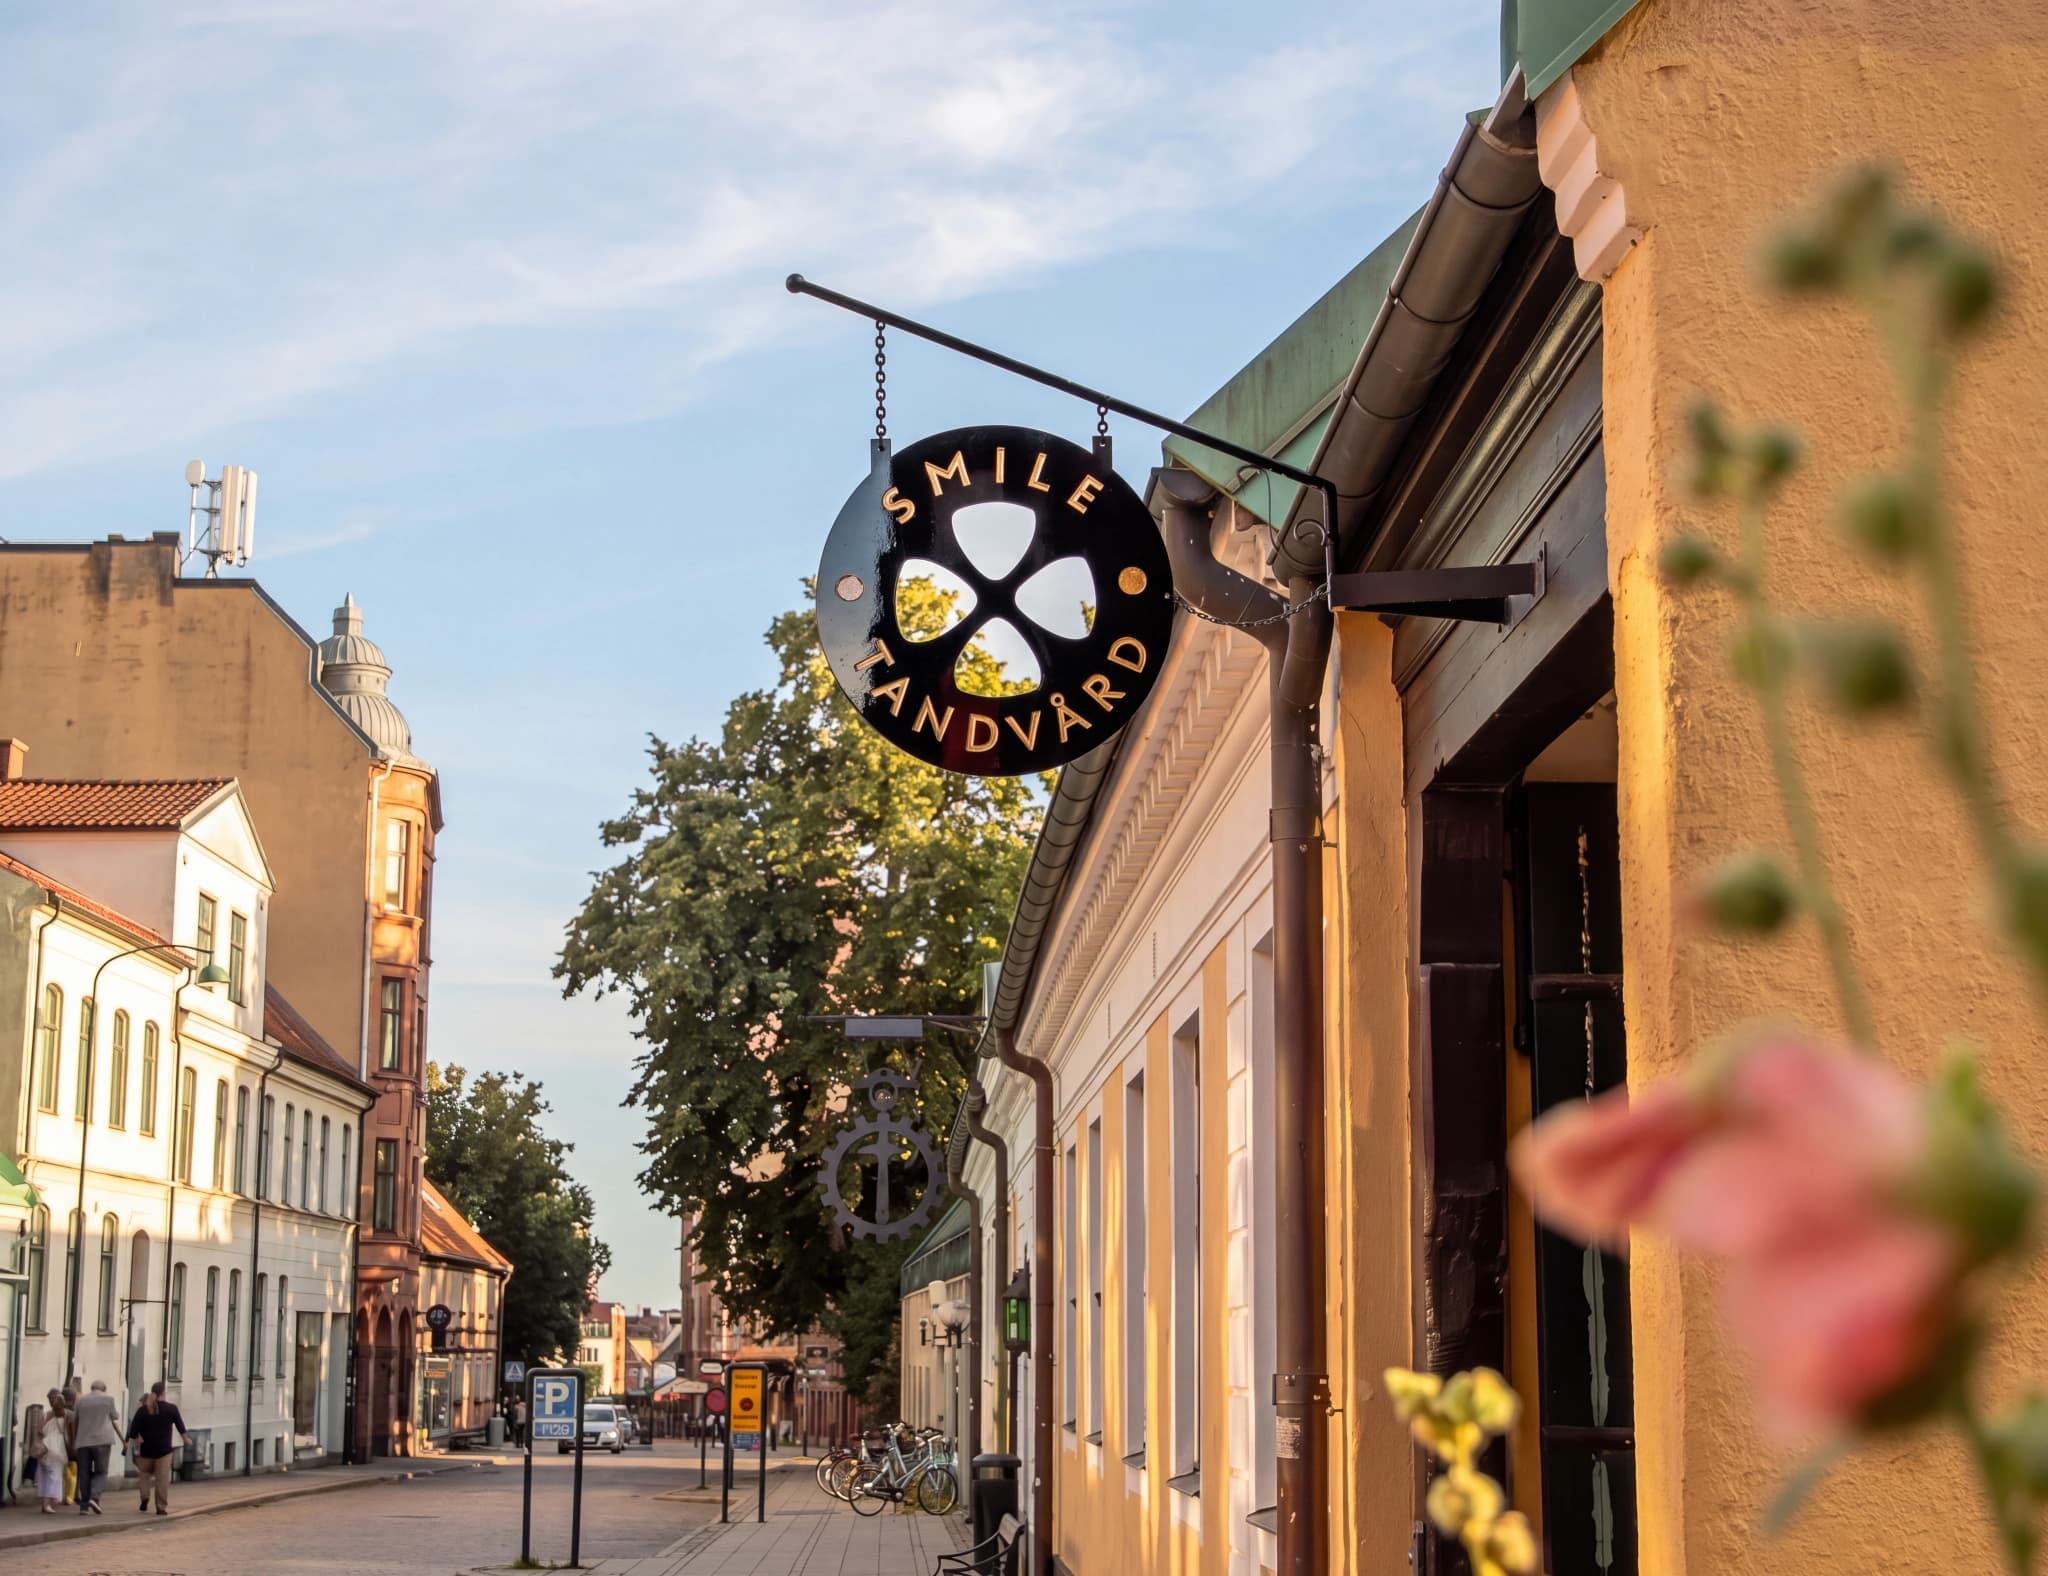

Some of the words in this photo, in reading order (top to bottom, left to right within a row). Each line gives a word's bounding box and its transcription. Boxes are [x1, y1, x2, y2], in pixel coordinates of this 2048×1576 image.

[880, 446, 1105, 525] SMILE
[853, 636, 1148, 754] TANDVÅRD
[544, 1381, 570, 1415] P
